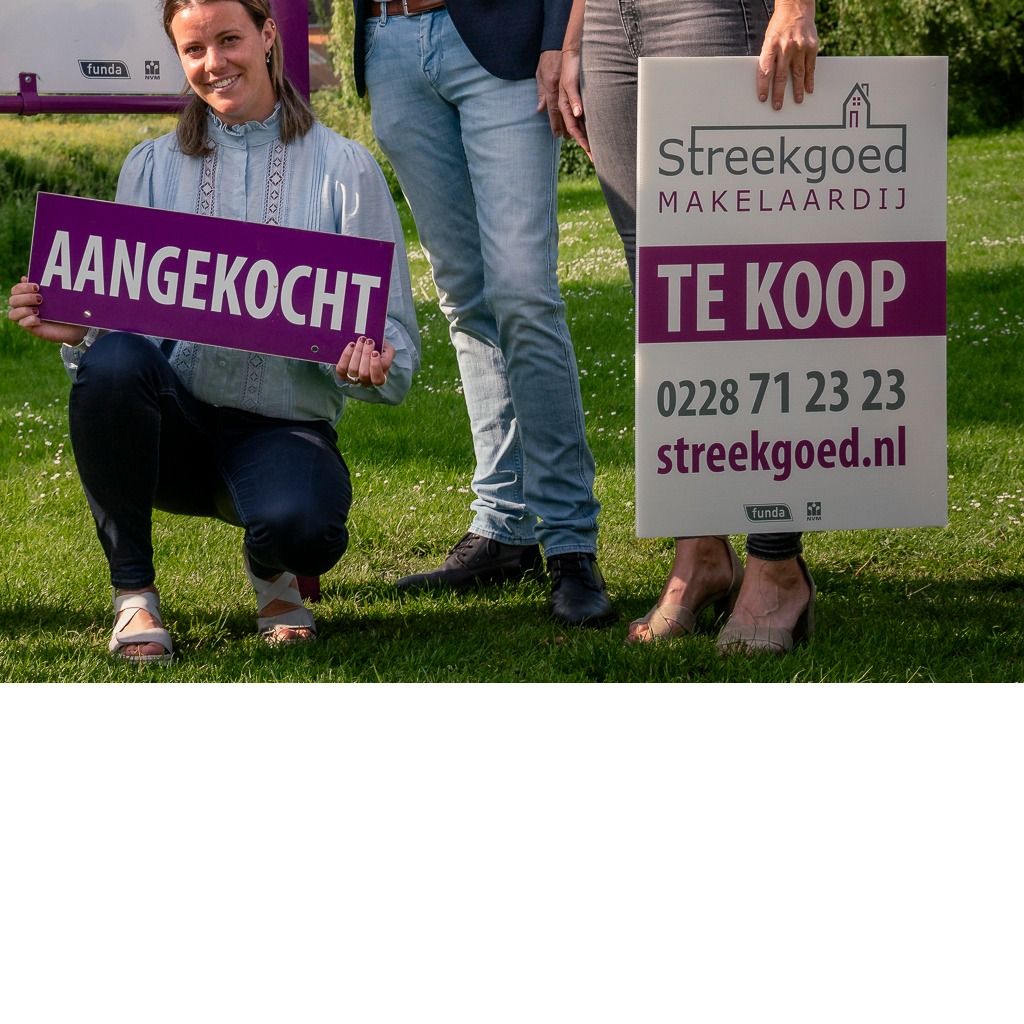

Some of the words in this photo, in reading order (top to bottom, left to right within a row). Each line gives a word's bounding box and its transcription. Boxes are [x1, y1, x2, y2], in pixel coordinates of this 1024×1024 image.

[86, 63, 123, 76] funda
[658, 125, 907, 184] Streekgoed
[659, 187, 906, 214] MAKELAARDIJ
[40, 230, 382, 335] AANGEKOCHT
[657, 263, 725, 332] TE
[746, 259, 906, 330] KOOP
[657, 378, 739, 417] 0228
[749, 372, 790, 415] 71
[805, 370, 849, 412] 23
[862, 368, 906, 411] 23
[657, 425, 907, 482] streekgoed.nl
[751, 506, 786, 519] funda
